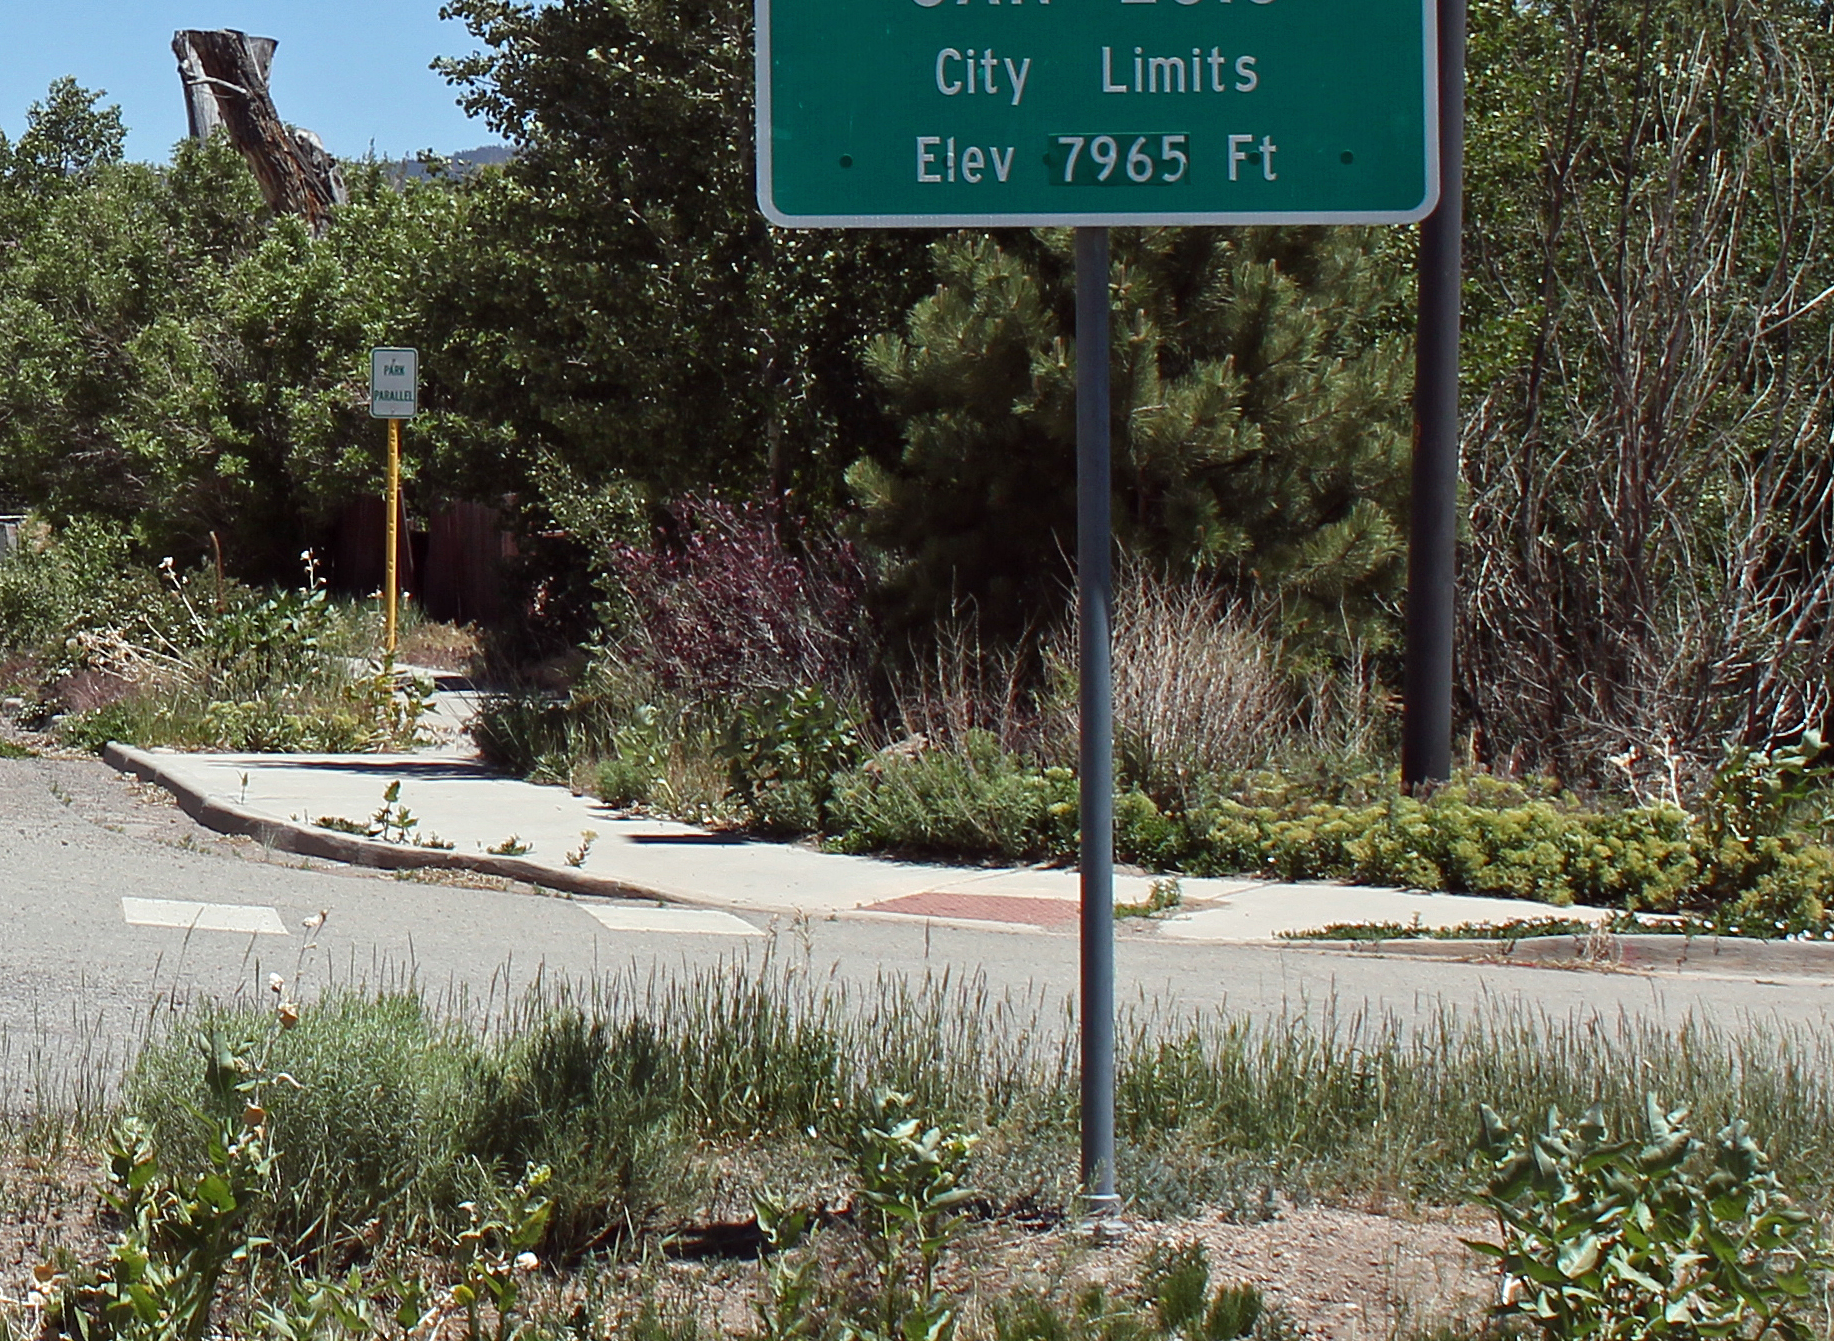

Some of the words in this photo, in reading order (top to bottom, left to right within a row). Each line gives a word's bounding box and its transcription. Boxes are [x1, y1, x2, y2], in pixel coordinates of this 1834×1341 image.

[937, 48, 1030, 105] City
[1103, 47, 1257, 92] Limits
[917, 137, 1014, 183] Elev
[1059, 136, 1187, 181] 7965
[1229, 135, 1276, 180] Ft
[383, 364, 405, 376] PARK
[374, 389, 414, 402] PARALLEL
